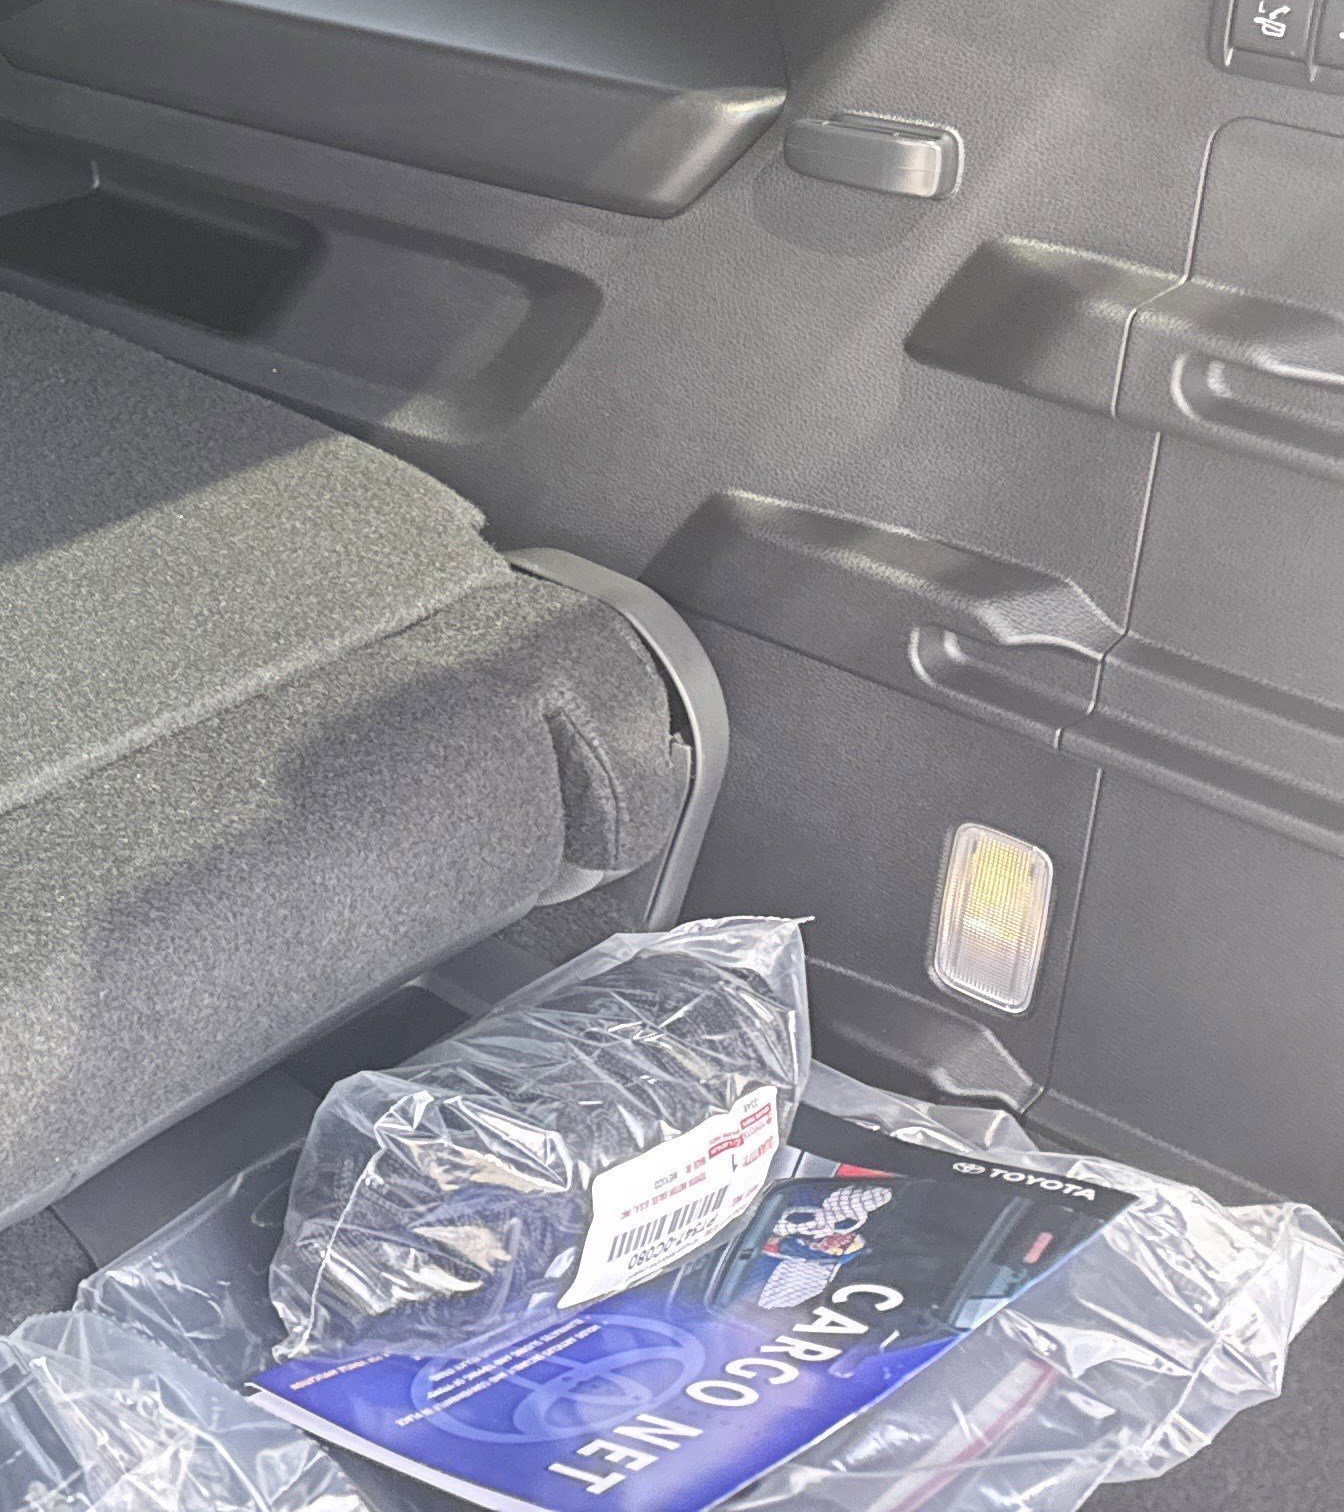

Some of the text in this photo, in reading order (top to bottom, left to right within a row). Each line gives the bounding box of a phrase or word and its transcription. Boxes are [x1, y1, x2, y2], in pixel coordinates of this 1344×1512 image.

[989, 1167, 1096, 1201] TOYOTA
[685, 1284, 904, 1407] CARGO
[547, 1413, 703, 1495] NET
